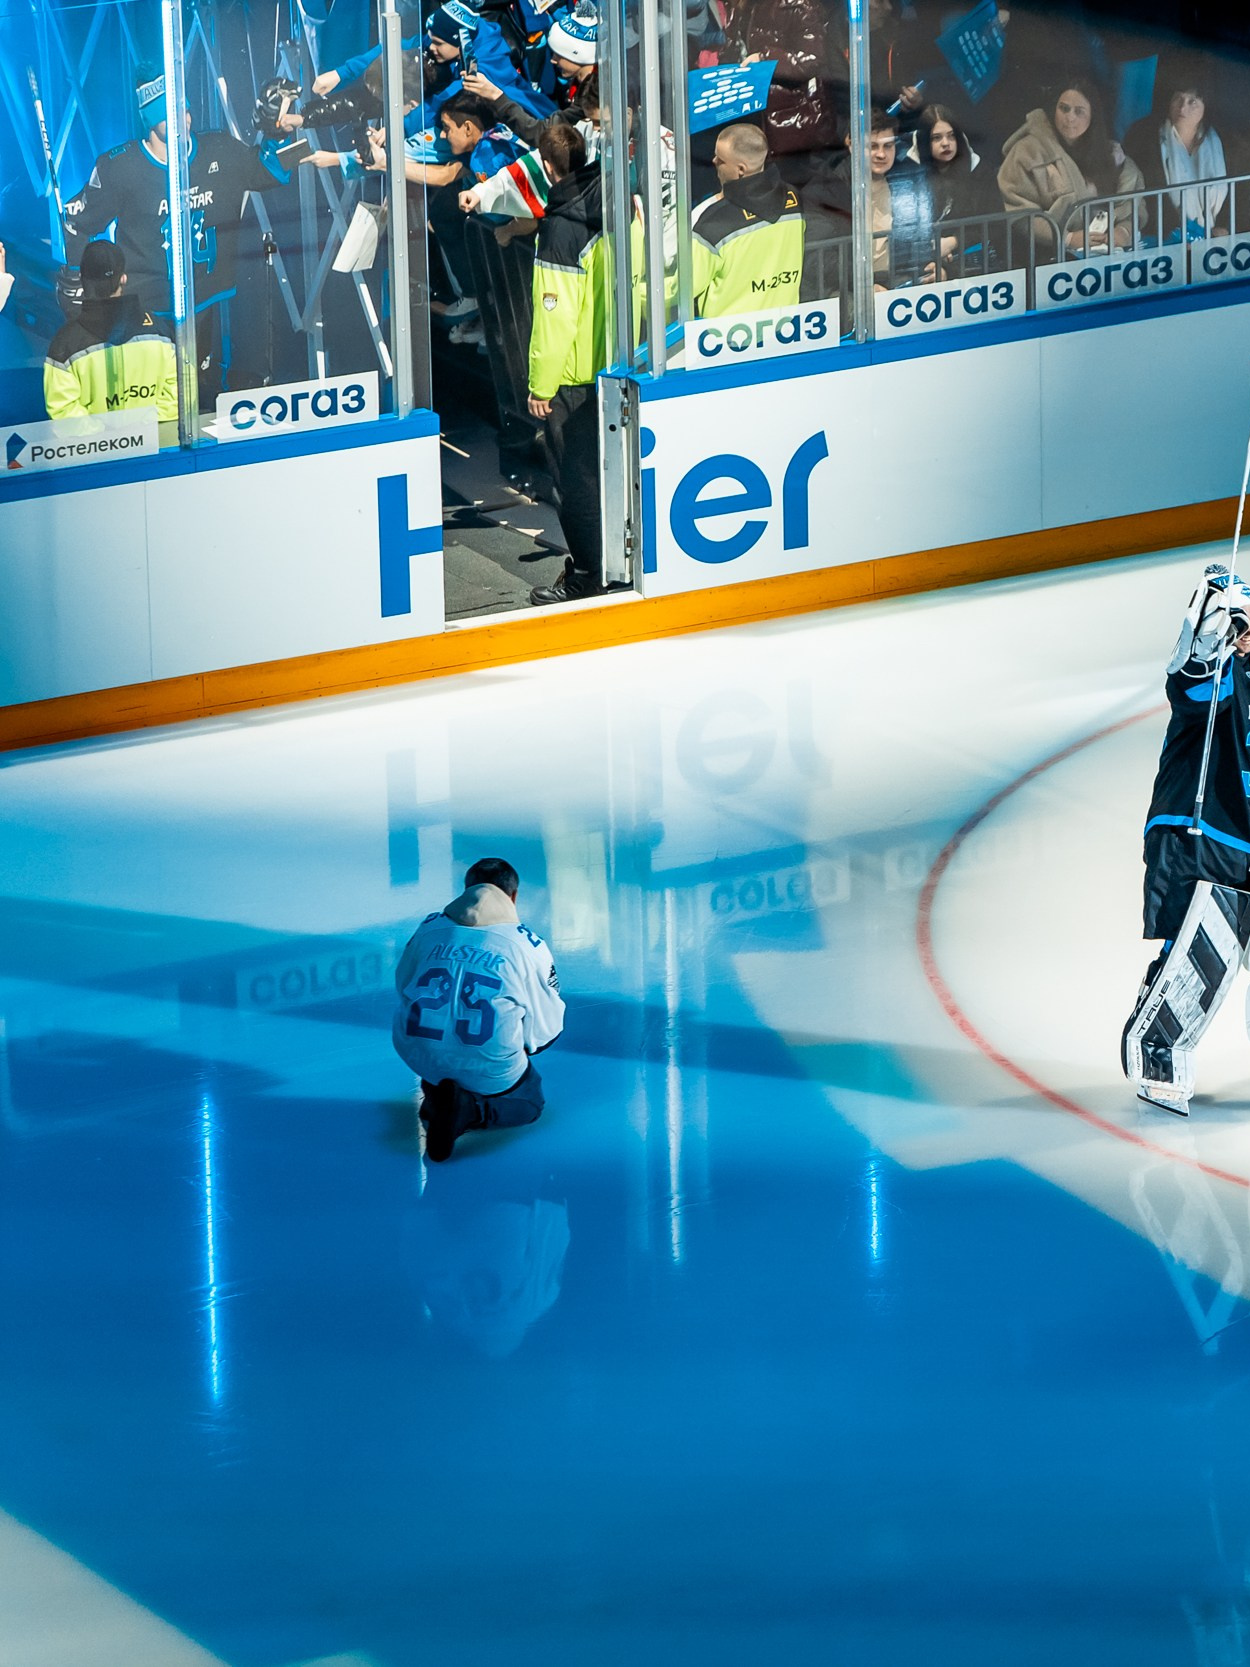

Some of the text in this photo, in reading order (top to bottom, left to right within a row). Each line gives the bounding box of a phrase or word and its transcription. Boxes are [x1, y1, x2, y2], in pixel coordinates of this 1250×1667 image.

[1047, 255, 1173, 301] согаз
[887, 281, 1014, 328] согаз
[698, 311, 827, 357] согаз
[230, 384, 366, 430] согаз
[31, 435, 143, 462] Ростелеком
[406, 968, 502, 1046] 25
[1136, 979, 1171, 1035] TRUE
